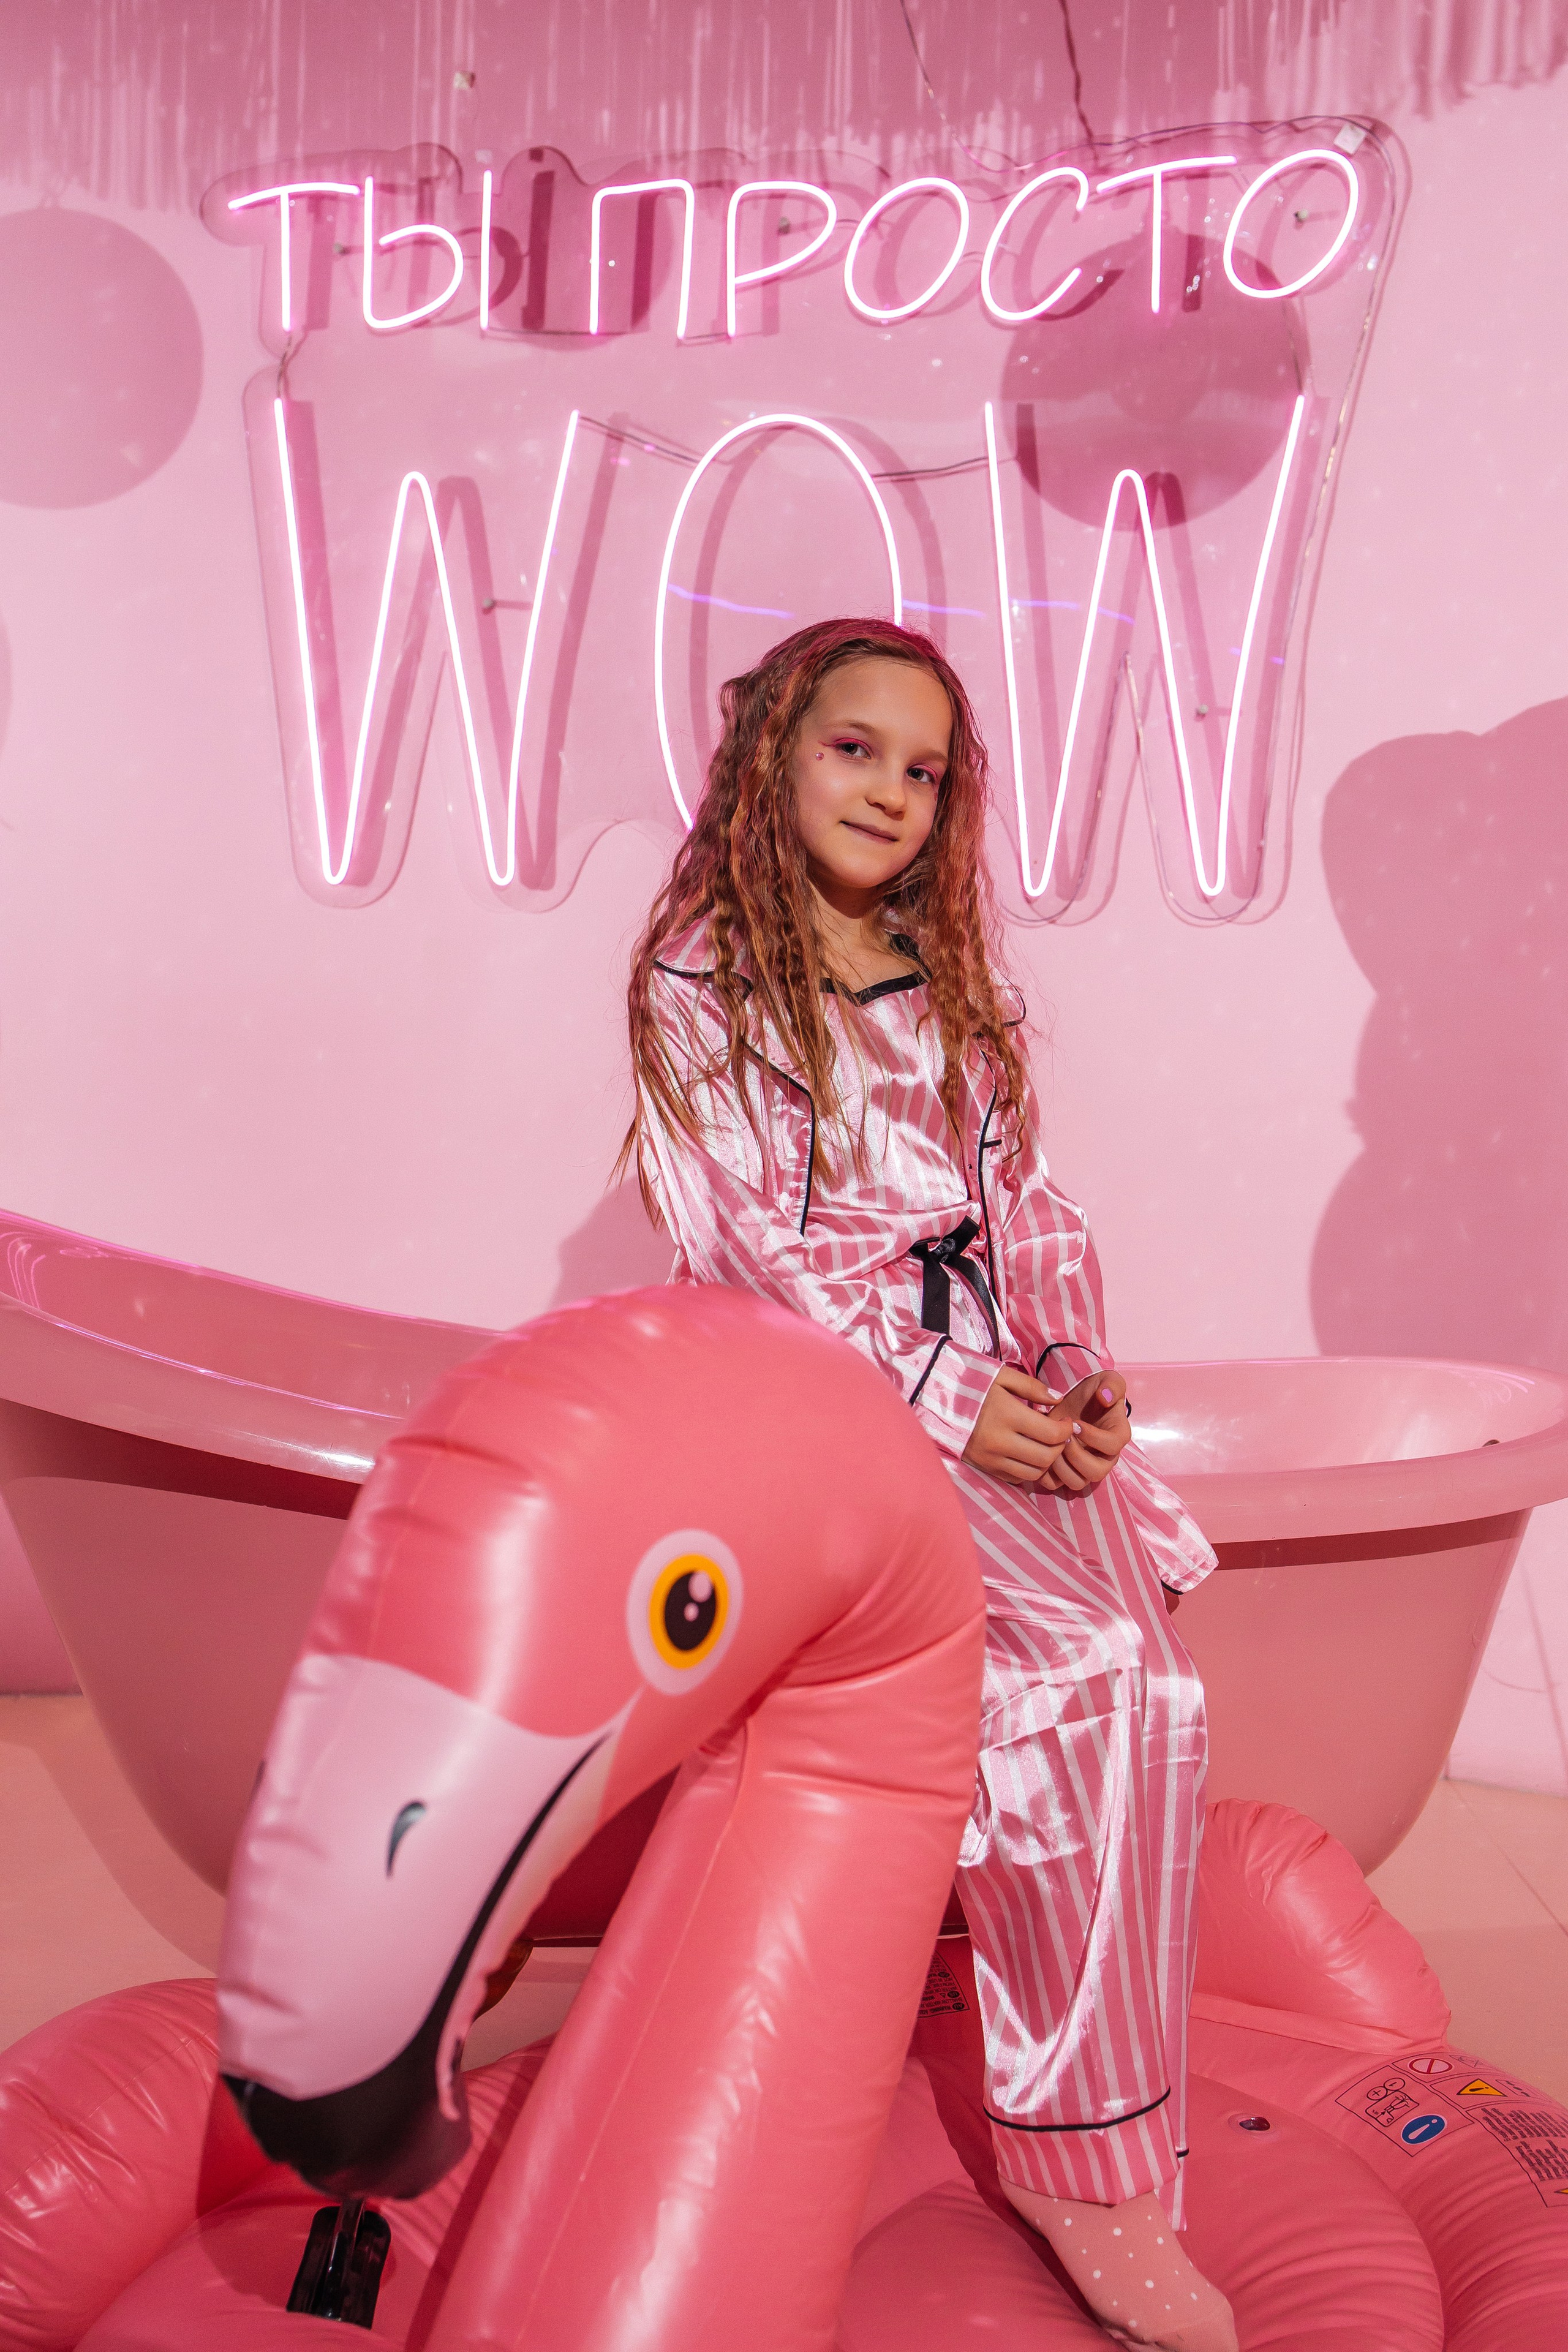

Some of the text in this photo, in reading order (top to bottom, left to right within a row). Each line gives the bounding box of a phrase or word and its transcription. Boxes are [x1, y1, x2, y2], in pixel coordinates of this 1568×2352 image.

[227, 148, 1360, 339] ТЫ ПРОСТО
[272, 394, 1306, 899] WOW
